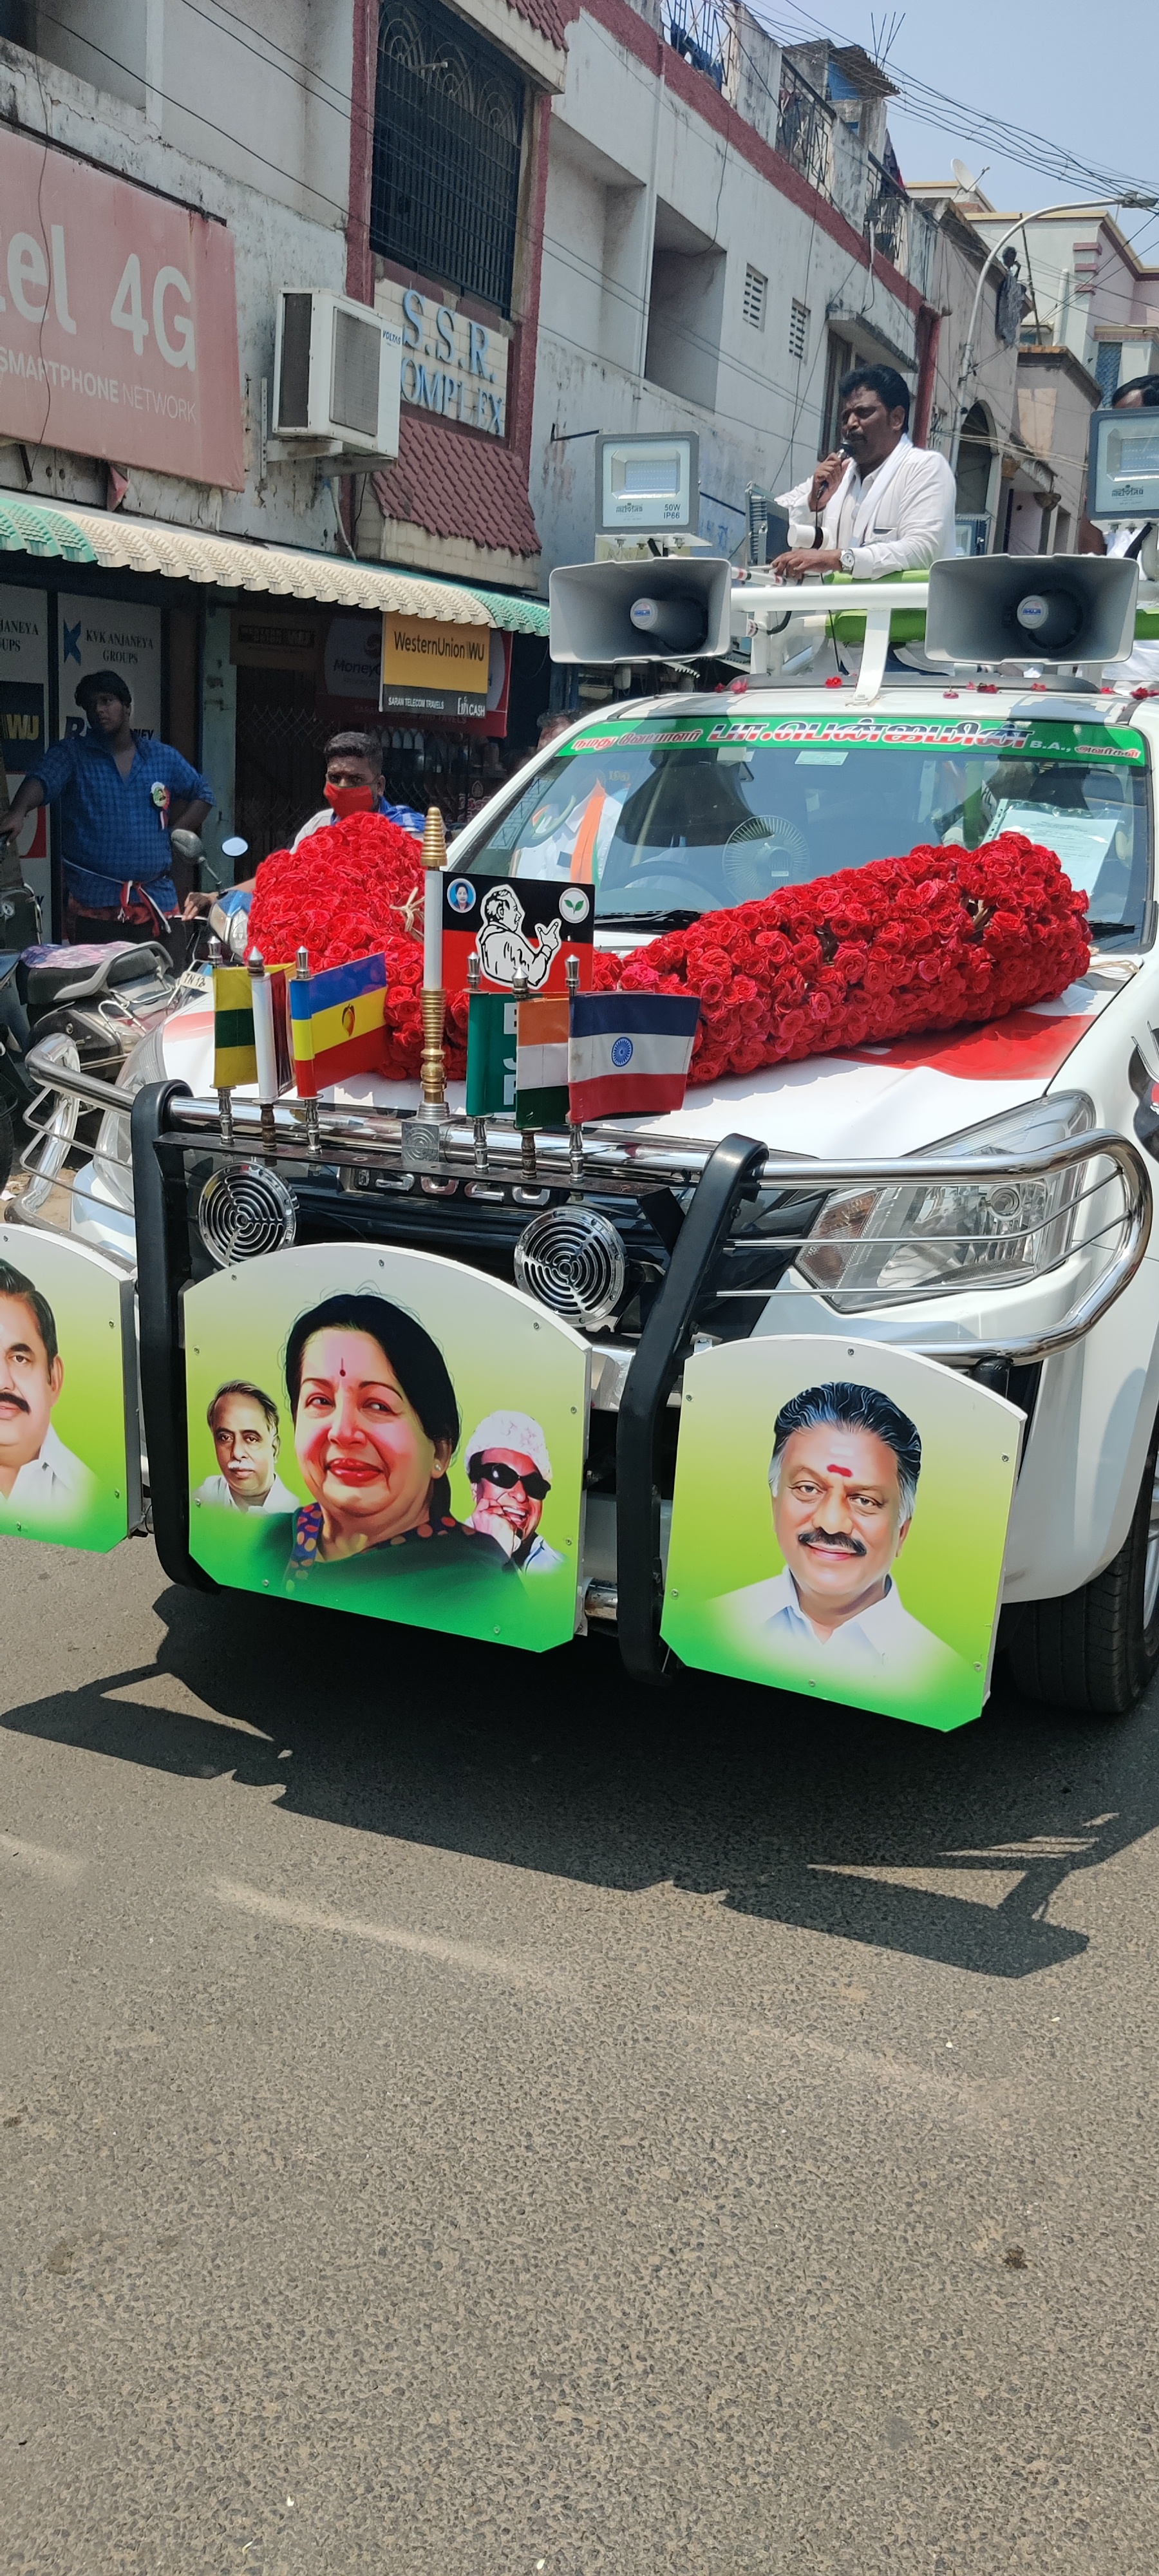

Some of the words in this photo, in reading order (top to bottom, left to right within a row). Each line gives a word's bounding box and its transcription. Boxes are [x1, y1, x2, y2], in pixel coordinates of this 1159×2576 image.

[0, 225, 77, 334] el
[111, 253, 196, 372] 4G
[382, 329, 401, 345] VOLTAS
[0, 346, 119, 404] SMARTPHONE
[122, 383, 196, 423] NETWORK
[400, 357, 504, 434] OMPLEX
[0, 618, 39, 636] JANEYA
[0, 637, 21, 652] UPS
[86, 629, 106, 643] KVK
[109, 633, 154, 650] ANJANEYA
[393, 630, 465, 658] WesternUnion
[468, 641, 485, 661] WU
[102, 649, 138, 664] GROUPS
[388, 697, 404, 706] SARAN
[404, 698, 426, 708] TELECOM
[426, 700, 444, 709] TRAVELS
[6, 714, 39, 741] WU
[570, 735, 617, 751] நமது
[1030, 740, 1071, 753] B.A.,
[1074, 744, 1142, 759] அவர்கள்
[184, 973, 196, 985] TN
